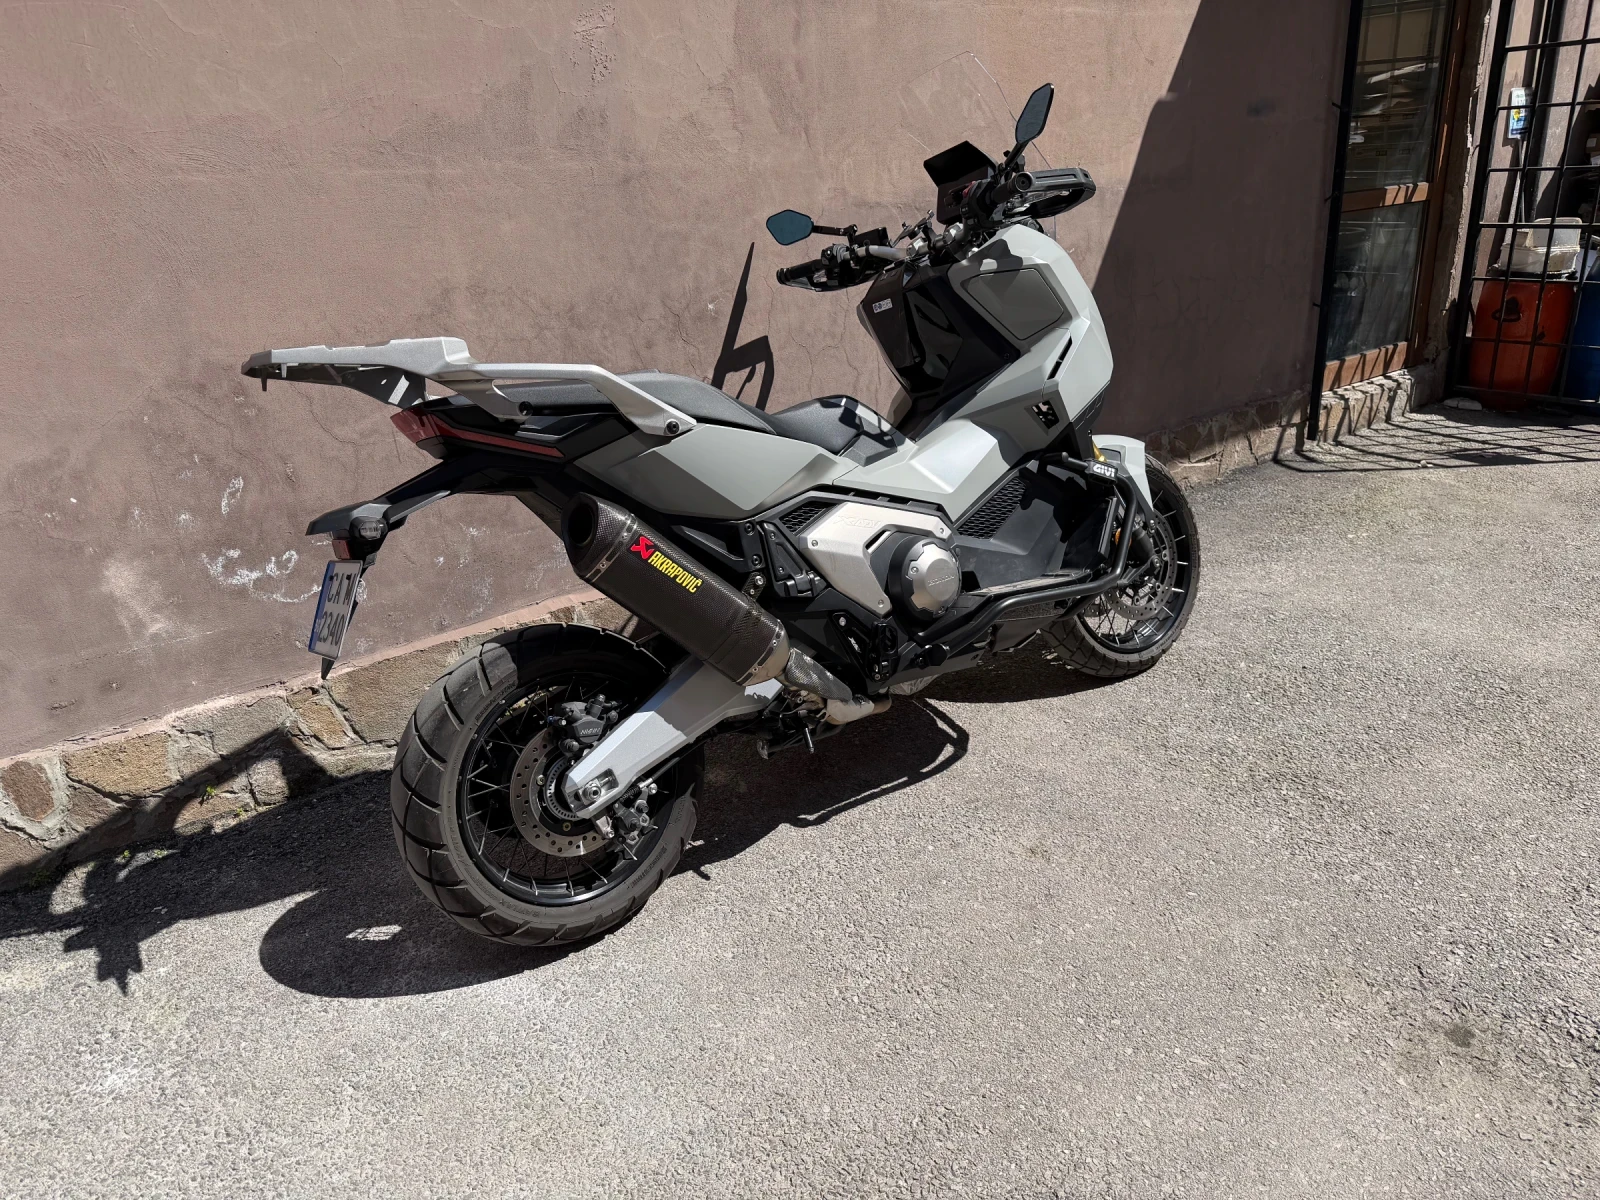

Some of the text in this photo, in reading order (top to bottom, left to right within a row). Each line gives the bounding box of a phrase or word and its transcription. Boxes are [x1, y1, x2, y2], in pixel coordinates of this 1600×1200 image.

[1092, 463, 1115, 478] GIVI
[327, 573, 344, 604] CA
[318, 611, 345, 646] 2340
